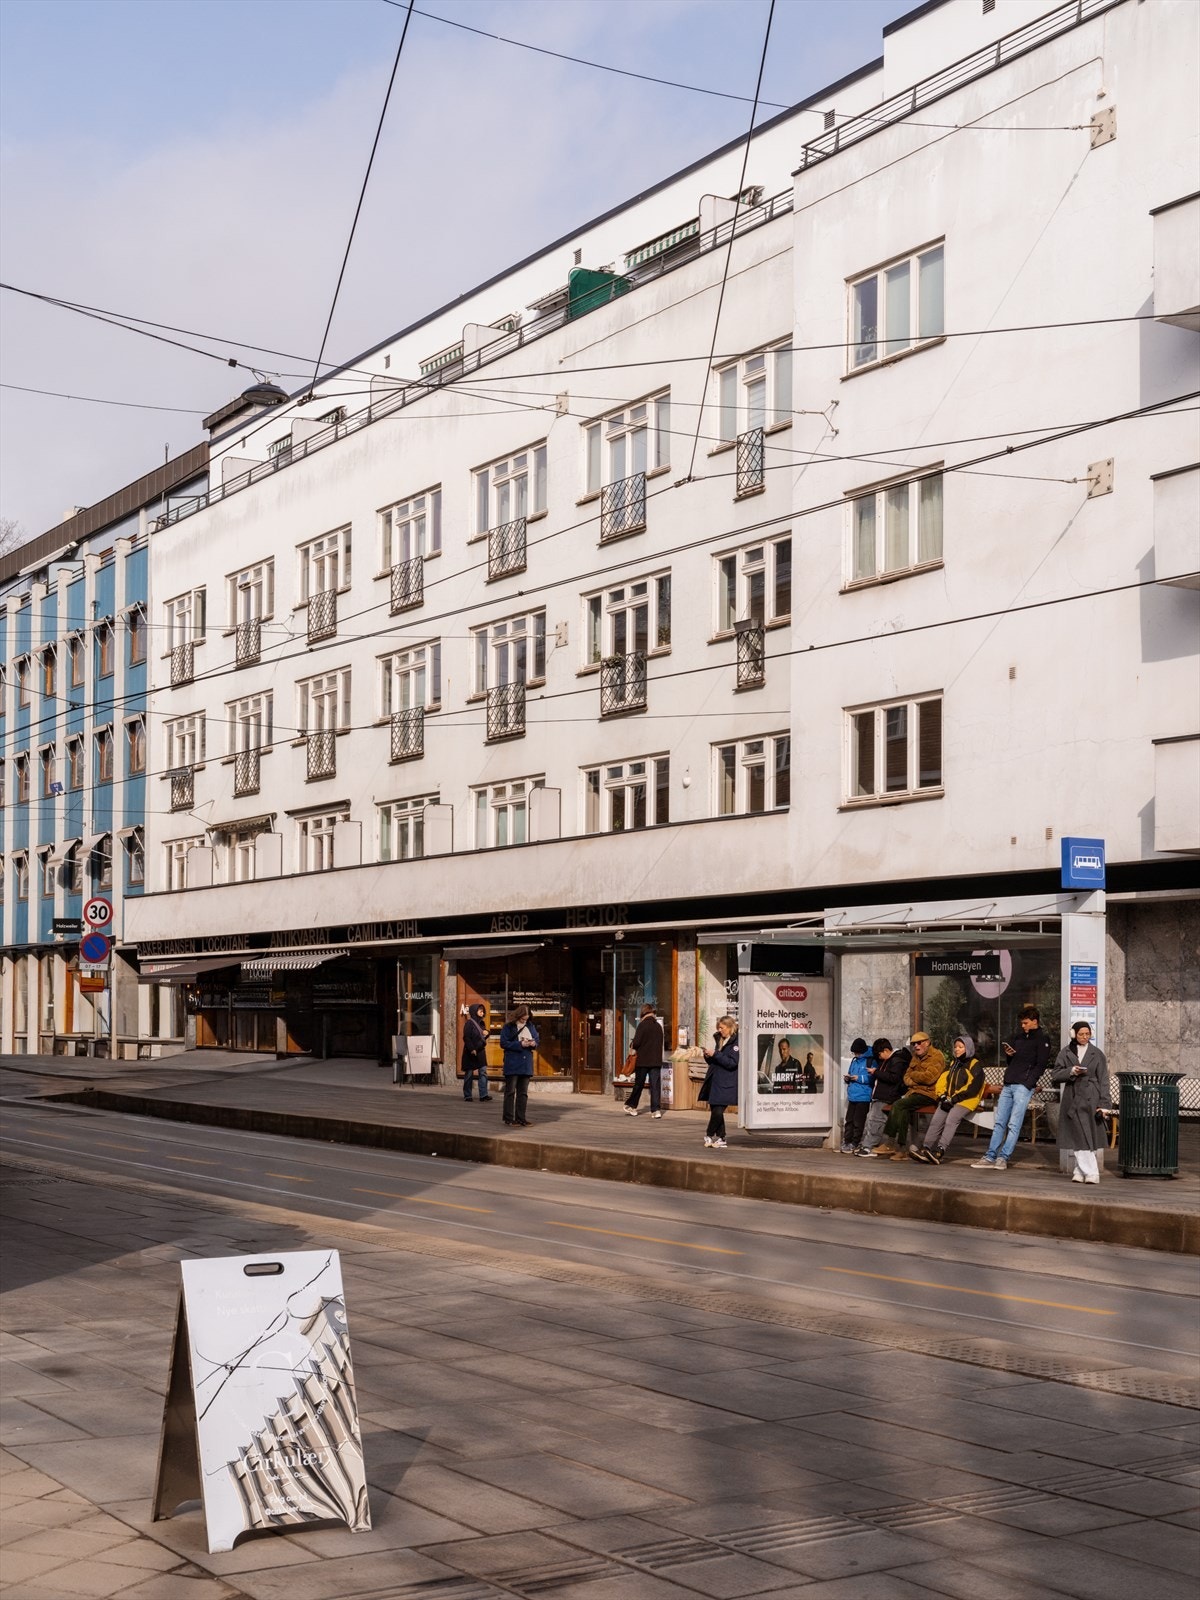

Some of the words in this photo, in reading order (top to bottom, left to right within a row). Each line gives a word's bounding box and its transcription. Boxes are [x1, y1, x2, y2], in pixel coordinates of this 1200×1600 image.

[89, 905, 108, 920] 30
[565, 904, 629, 929] HECTOR
[269, 927, 332, 948] ANTIKVARIAT
[347, 921, 394, 943] CAMILLA
[396, 919, 423, 939] PIHL
[136, 942, 163, 956] BAKER
[164, 938, 196, 955] HANSEN
[201, 934, 250, 952] L'OCCITANE
[931, 960, 982, 973] Homansbyen
[404, 992, 424, 1000] CAMILLA
[778, 988, 805, 998] altibox
[757, 1009, 808, 1020] Hele-Norges-
[756, 1020, 813, 1029] krimhelt-ibox?
[771, 1072, 795, 1082] HARRY
[243, 1448, 326, 1472] Cirkulær
